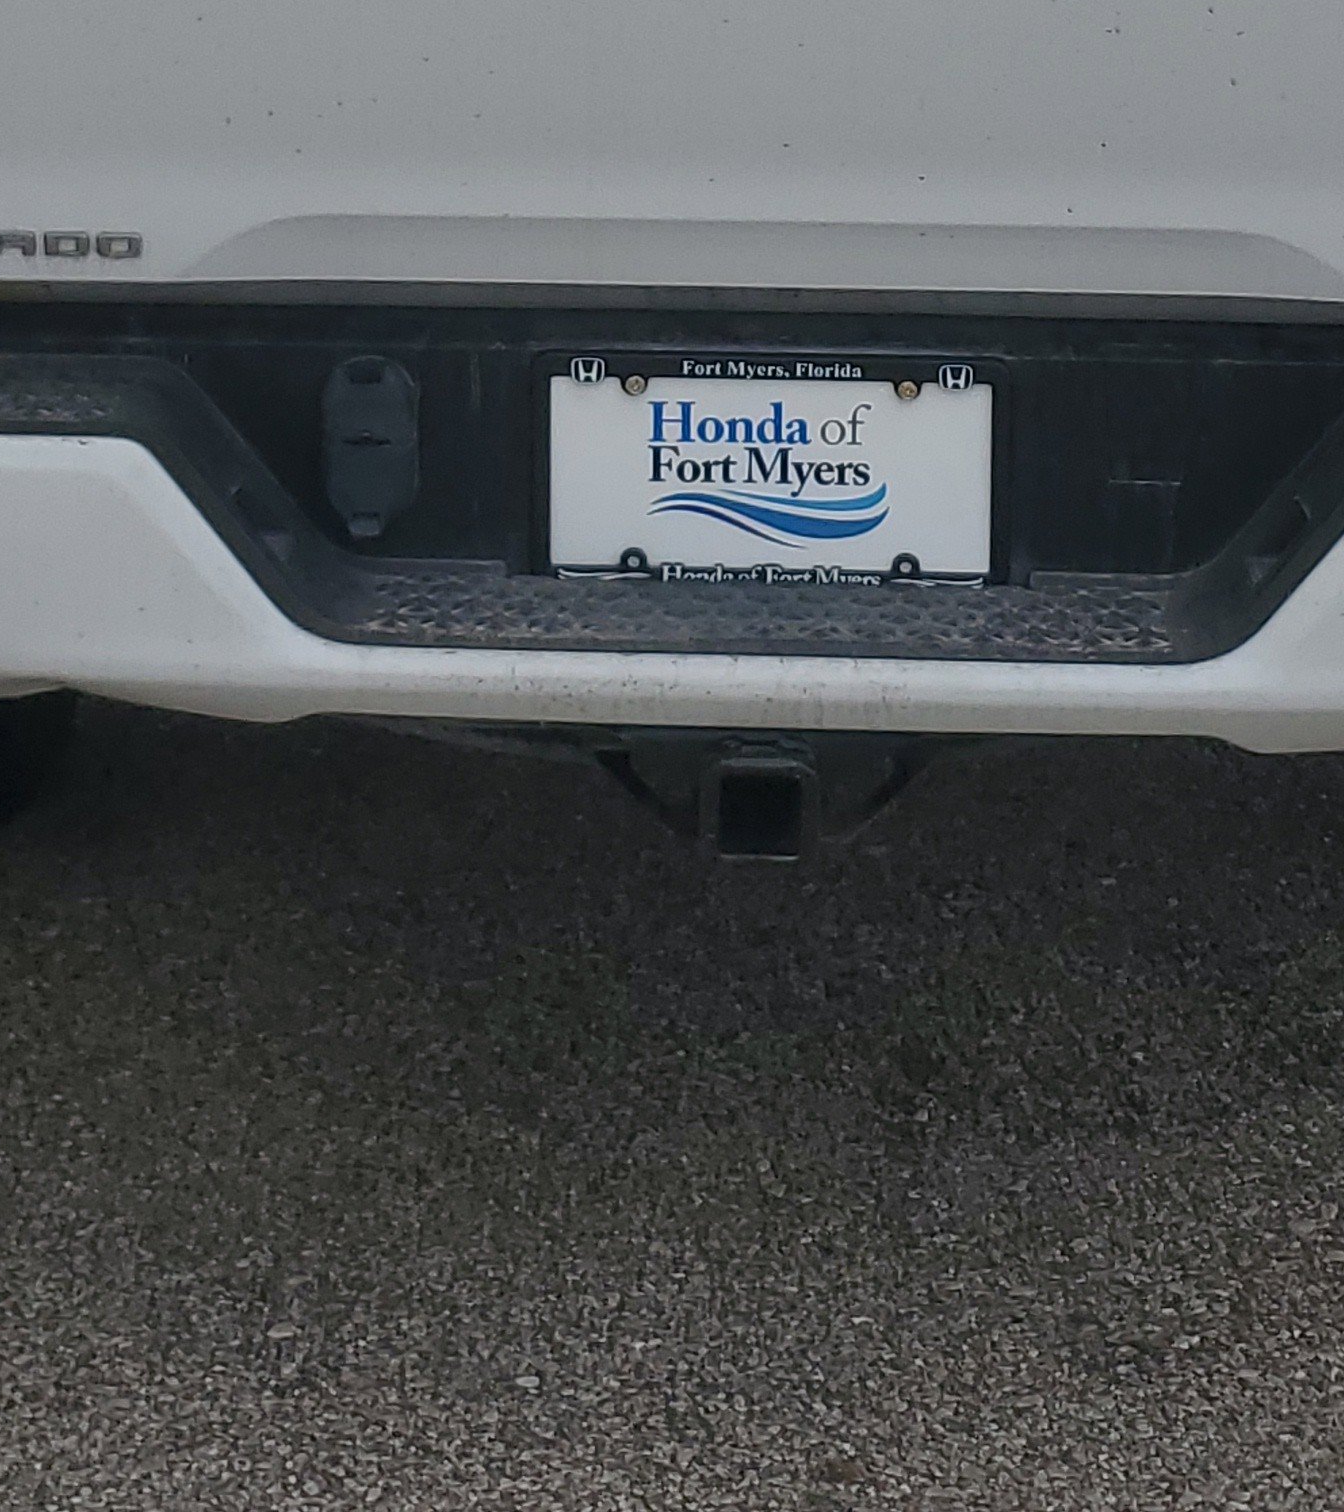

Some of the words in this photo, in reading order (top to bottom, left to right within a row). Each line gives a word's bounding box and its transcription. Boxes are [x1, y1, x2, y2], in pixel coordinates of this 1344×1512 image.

[682, 360, 722, 376] Fort
[727, 361, 791, 379] Myers,
[795, 362, 863, 378] Florida
[647, 400, 812, 445] Honda
[820, 403, 872, 445] of
[647, 445, 738, 483] Fort
[743, 446, 871, 497] Myers
